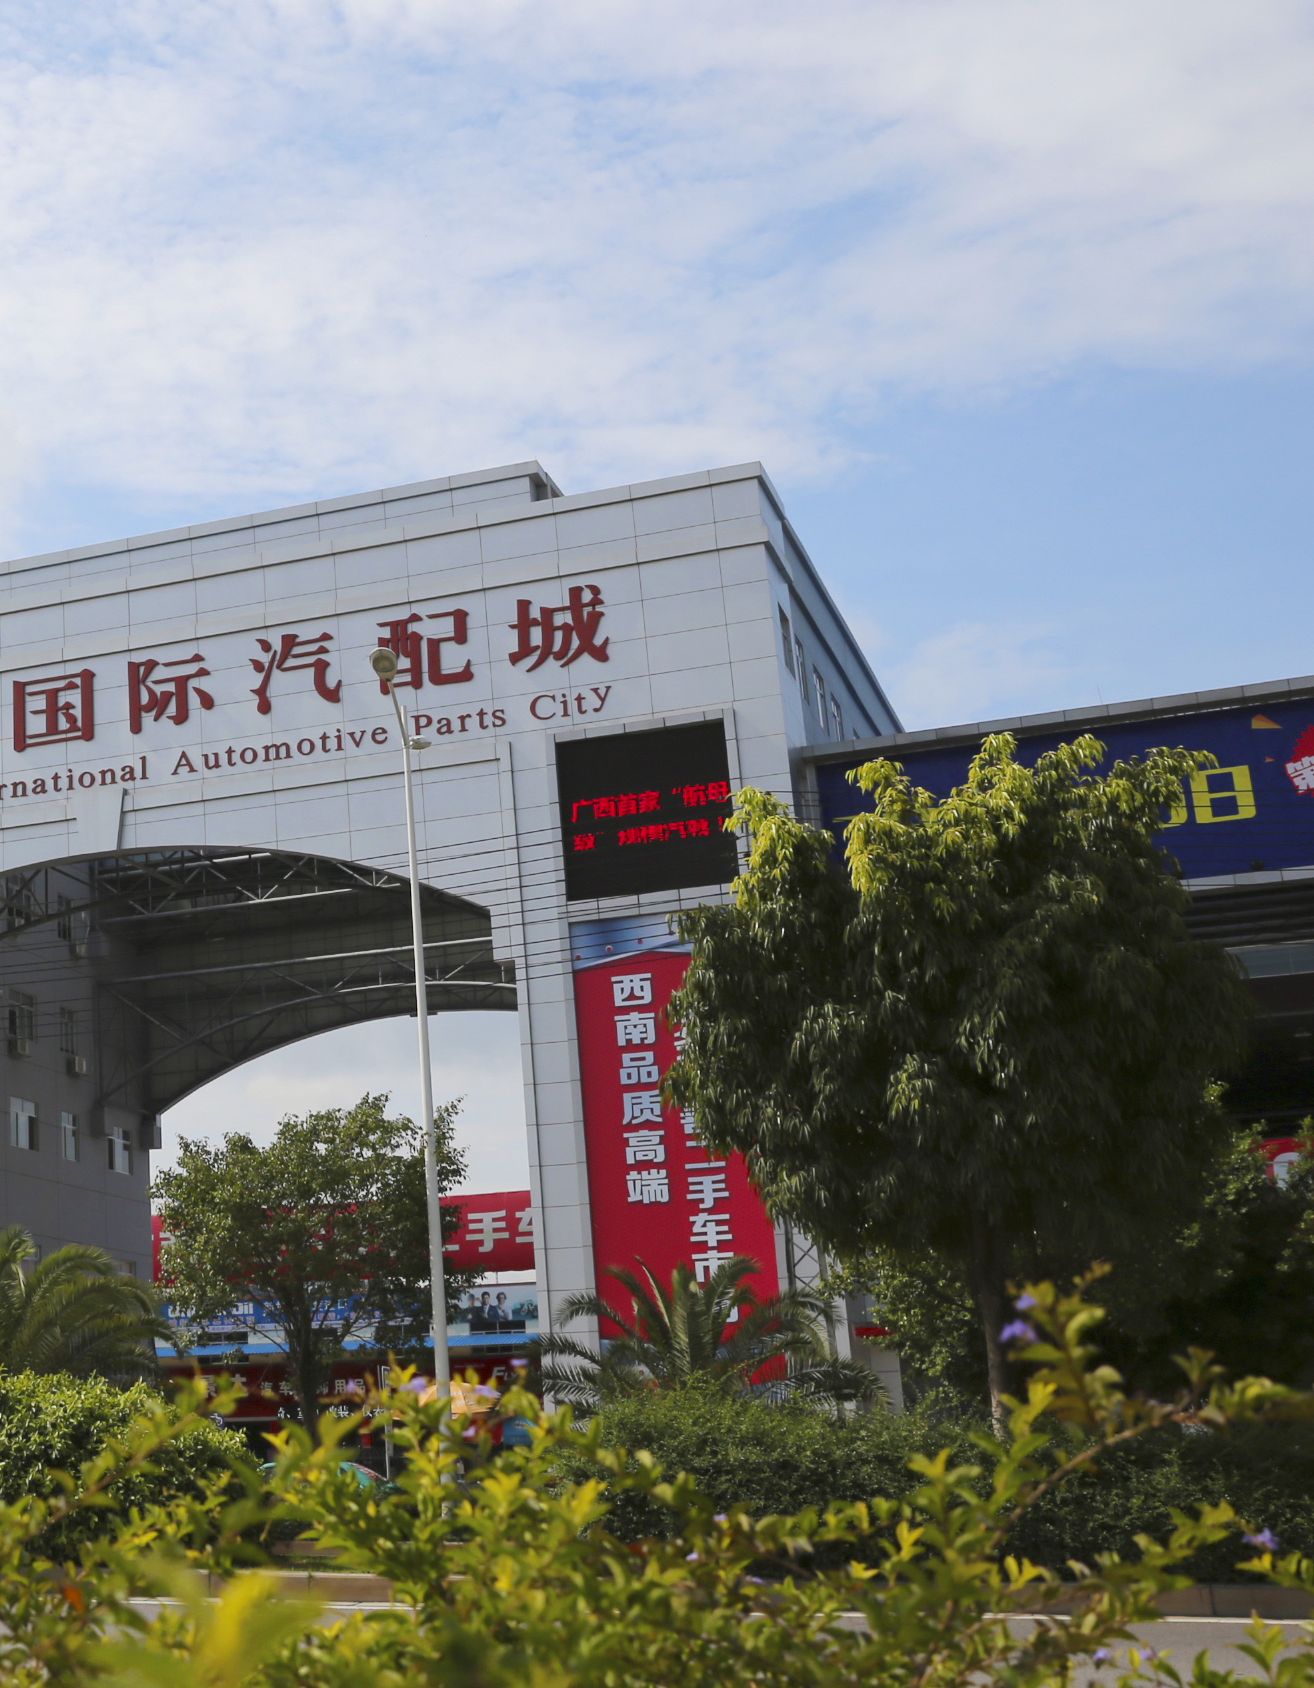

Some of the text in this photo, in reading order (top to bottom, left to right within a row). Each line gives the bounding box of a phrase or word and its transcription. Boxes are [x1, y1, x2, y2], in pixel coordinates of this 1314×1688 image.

[170, 725, 389, 777] Automotive
[410, 707, 507, 737] Parts
[529, 685, 612, 721] City
[610, 972, 670, 1205] 西南品质高端
